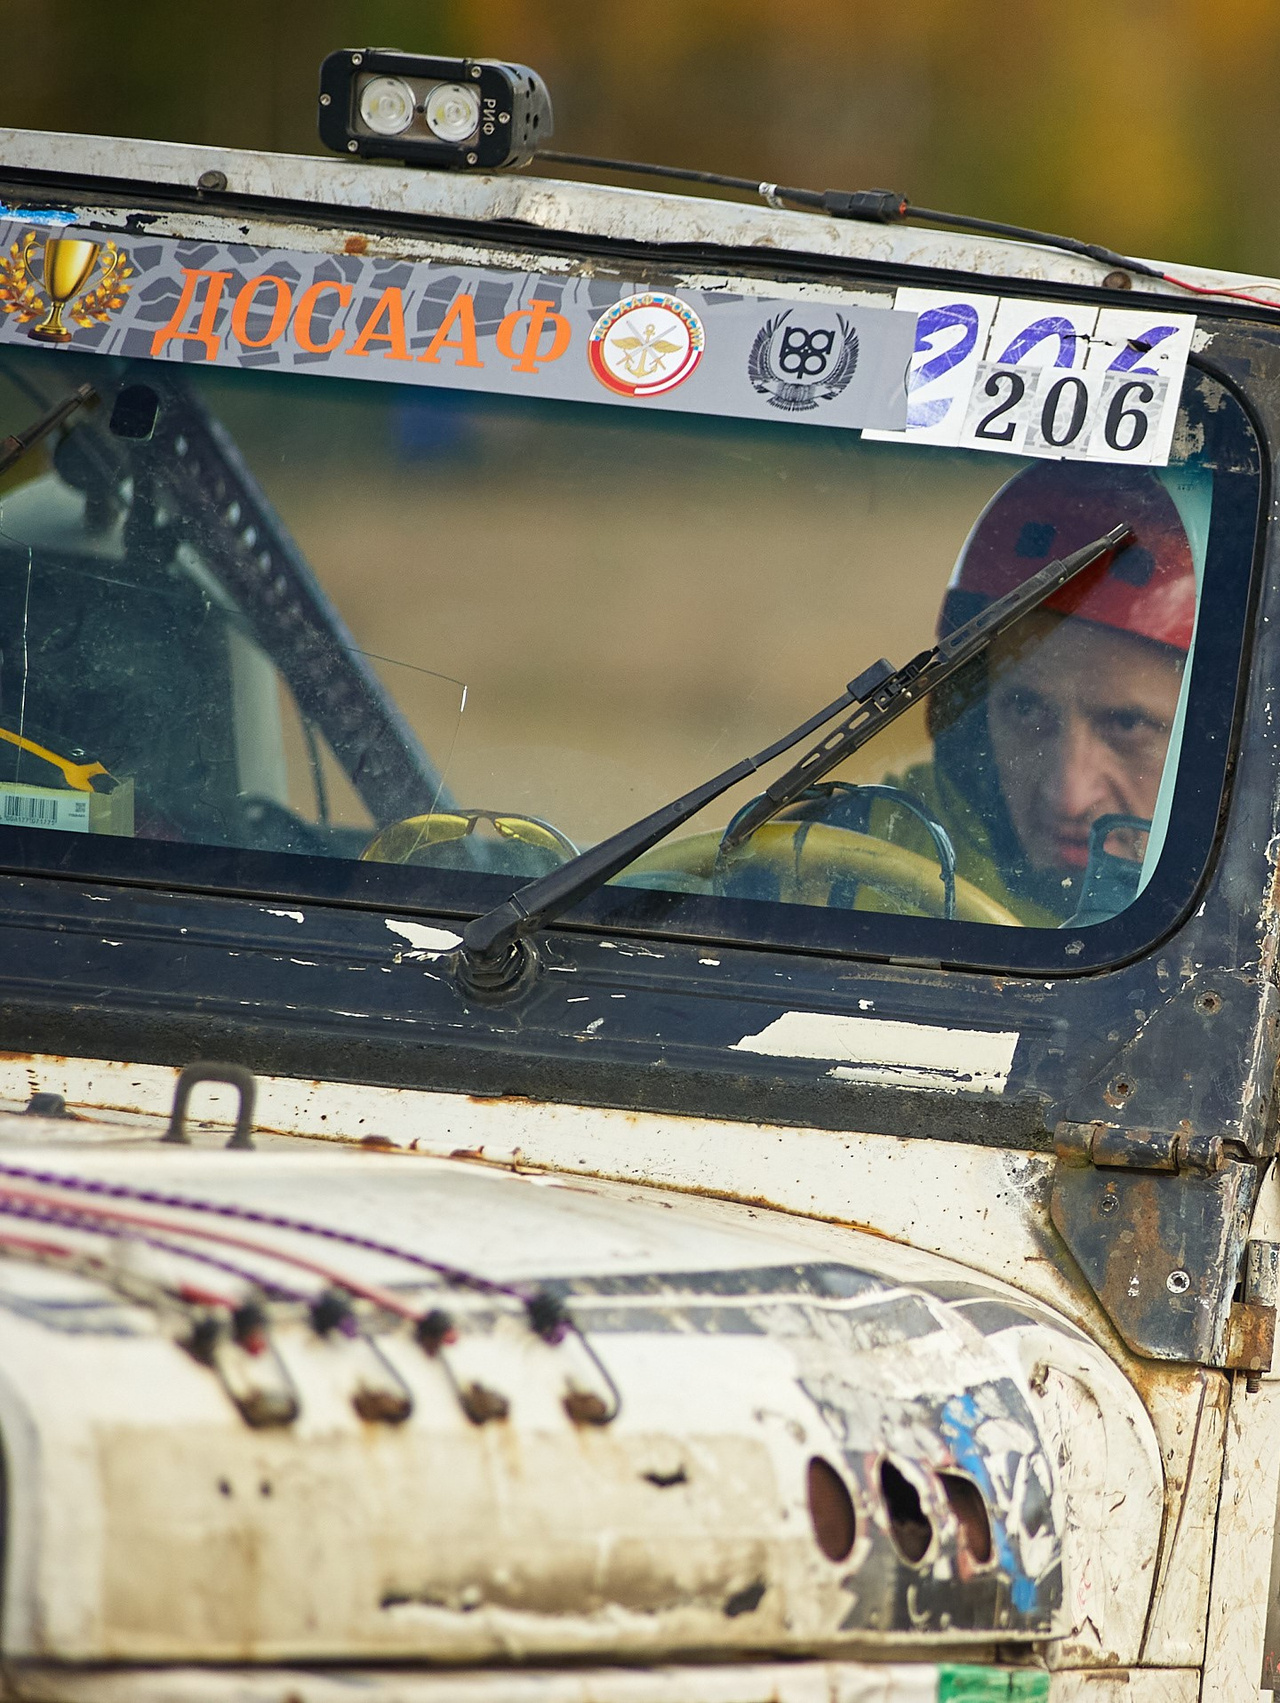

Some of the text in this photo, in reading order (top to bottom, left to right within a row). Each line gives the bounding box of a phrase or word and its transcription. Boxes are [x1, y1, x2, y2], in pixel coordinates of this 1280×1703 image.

[483, 98, 497, 135] РИФ
[150, 268, 573, 374] ДОСААФ
[593, 294, 703, 347] ДОСААФ РОССИИ
[975, 371, 1154, 451] 206
